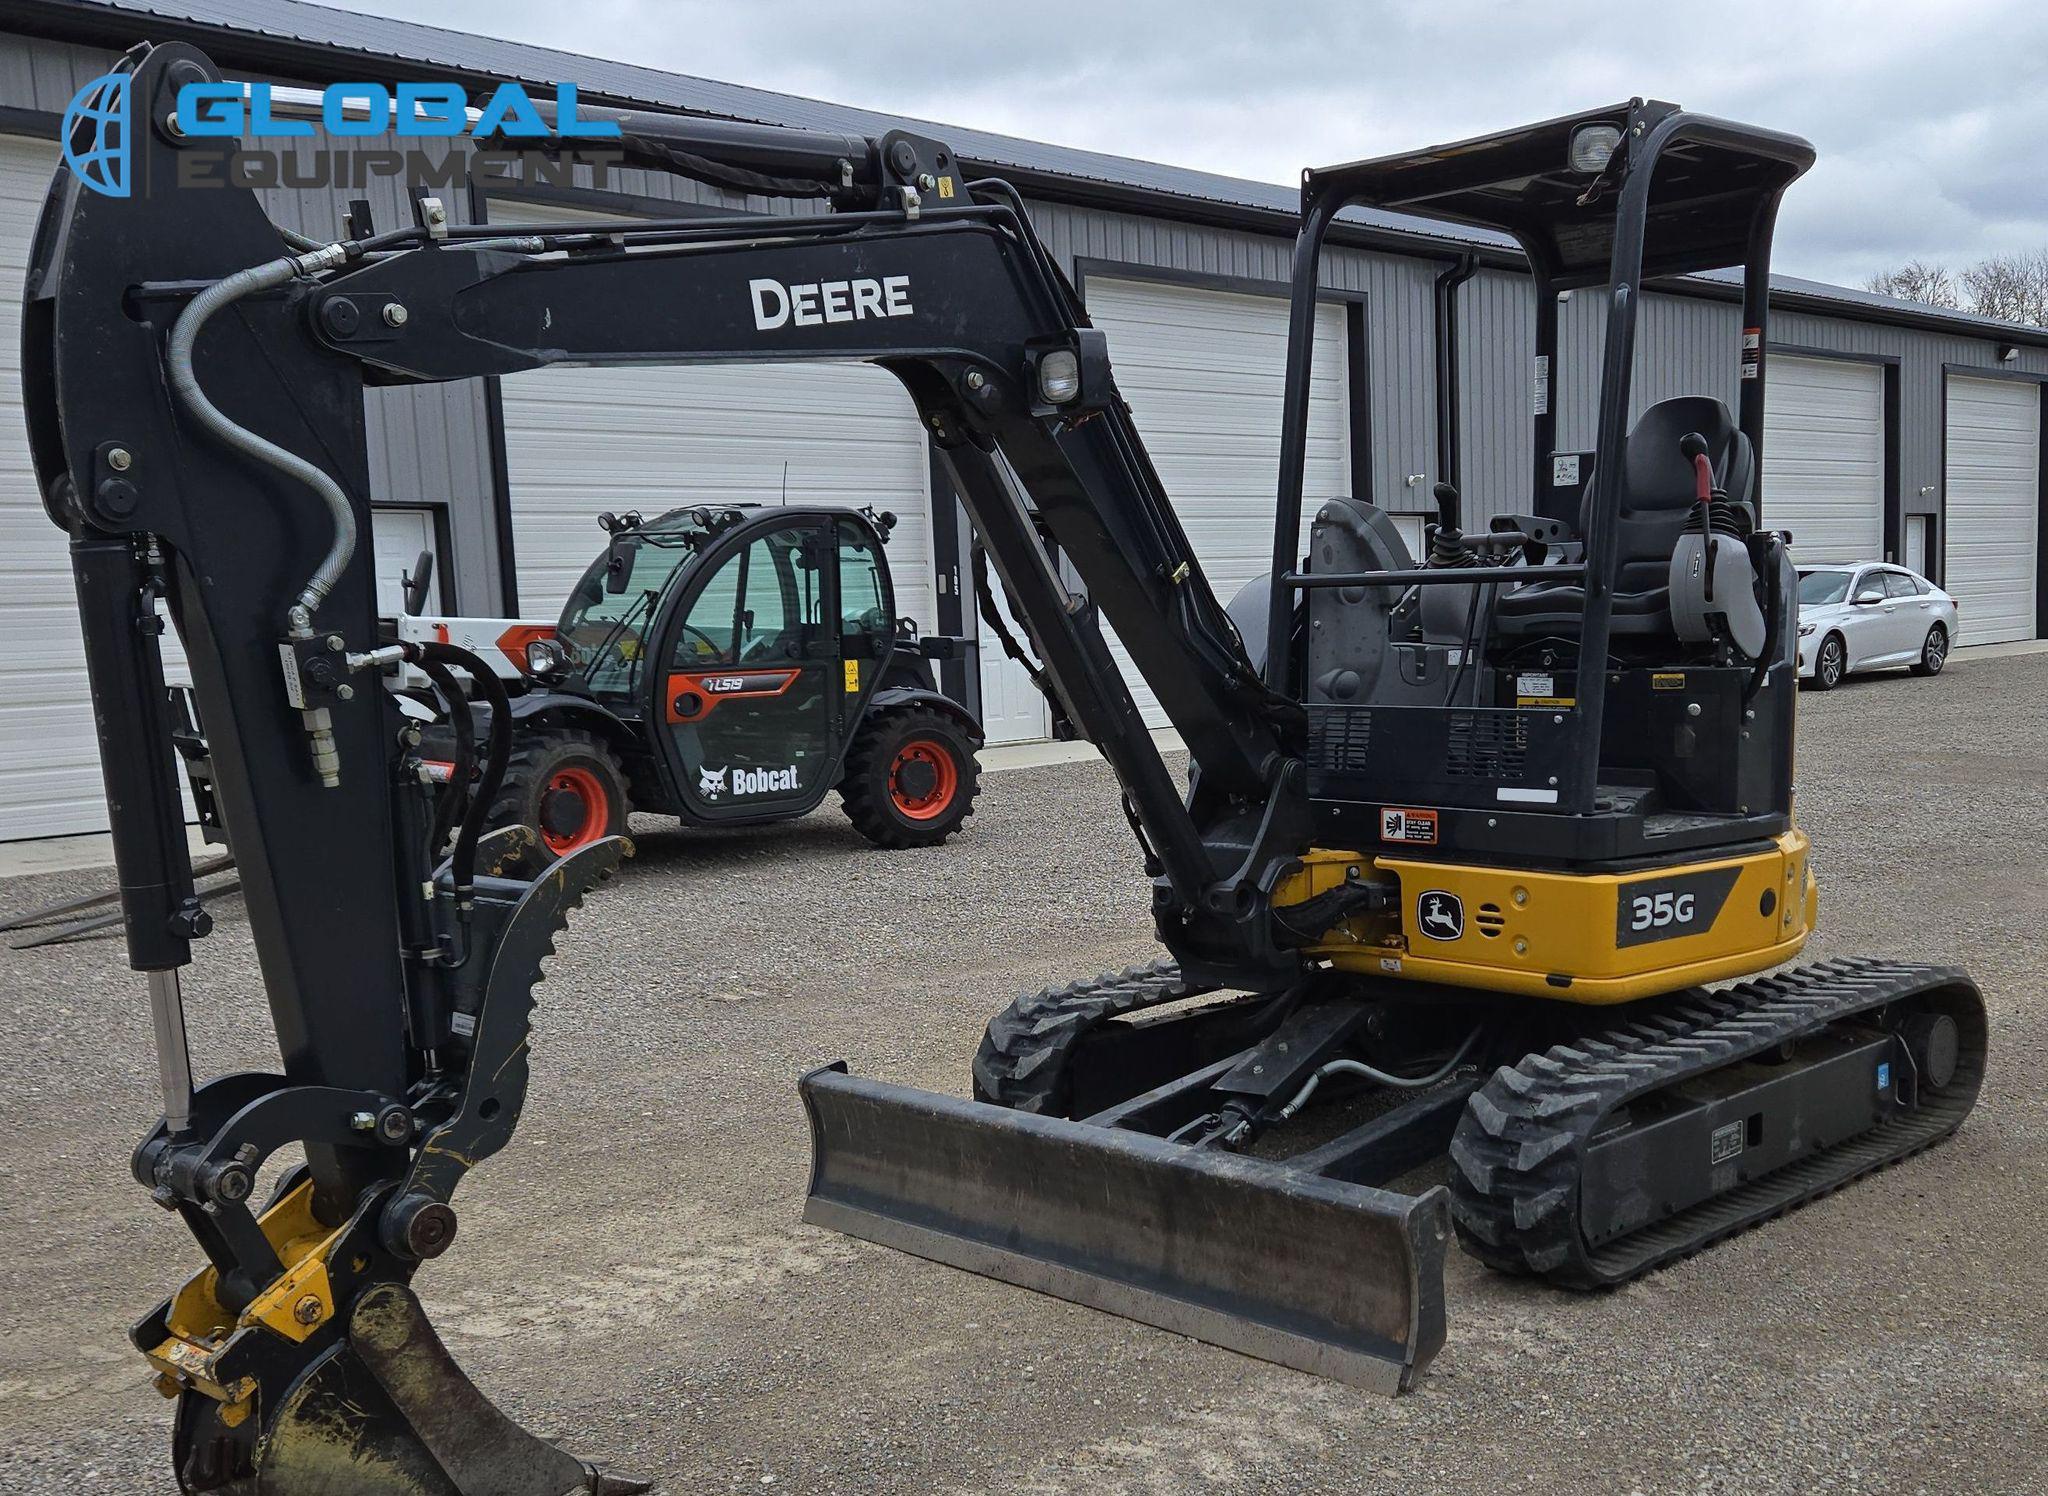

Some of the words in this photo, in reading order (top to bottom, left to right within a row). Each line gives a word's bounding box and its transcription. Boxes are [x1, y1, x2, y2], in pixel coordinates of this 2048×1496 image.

[749, 275, 914, 331] DEERE
[732, 765, 798, 795] Bobcat
[1632, 892, 1695, 931] 35G
